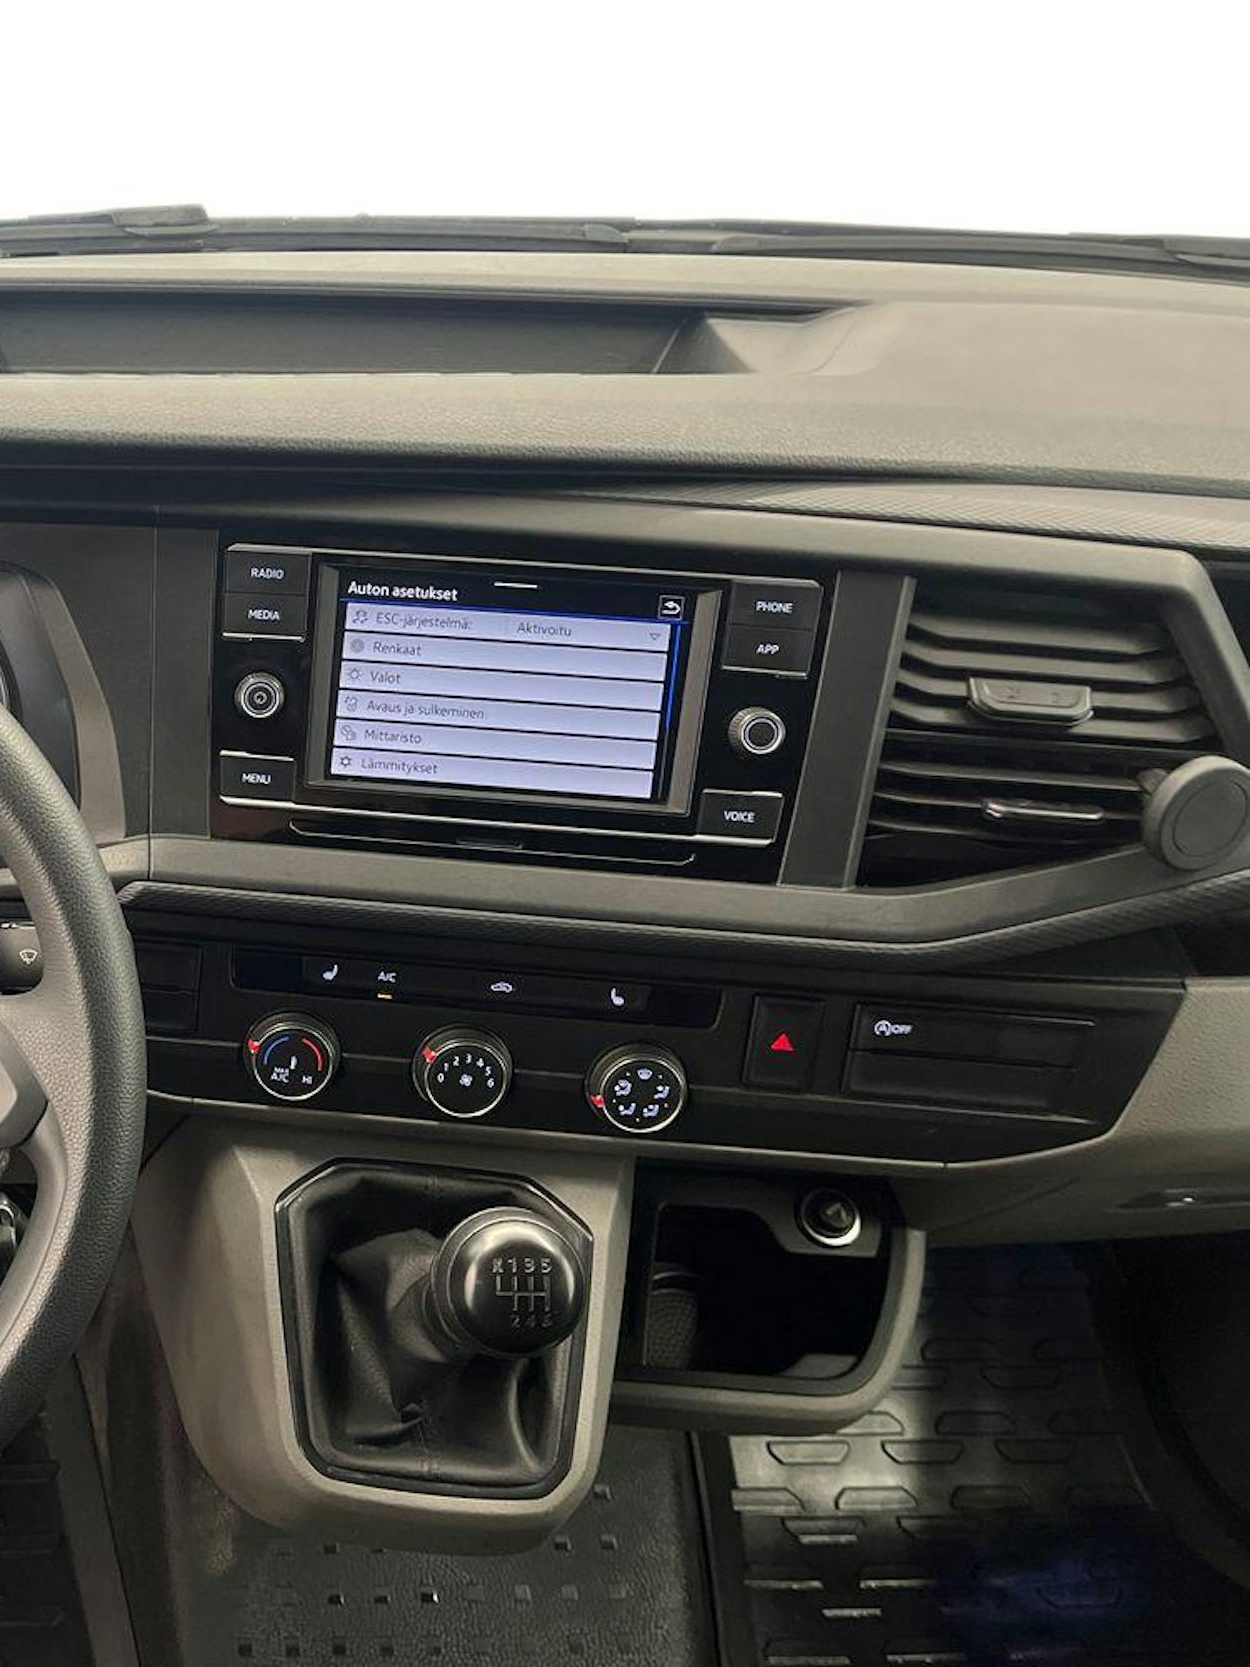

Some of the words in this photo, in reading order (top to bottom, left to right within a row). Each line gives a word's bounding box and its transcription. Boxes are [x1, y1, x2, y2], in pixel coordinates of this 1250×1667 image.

[251, 567, 285, 580] RADIO
[348, 581, 390, 597] Auton
[392, 586, 458, 601] asetukset
[755, 601, 794, 614] PHONE
[247, 609, 280, 621] MEDIA
[516, 622, 572, 637] Aktivoitu
[372, 641, 422, 657] Renkaat
[755, 643, 780, 655] APP
[370, 671, 402, 685] Valot
[366, 700, 401, 714] Avaus
[404, 704, 415, 717] ja
[417, 704, 485, 720] sulkeminen
[364, 729, 423, 745] Mittaristo
[361, 757, 439, 775] Lämmitykset
[241, 772, 271, 785] MENU
[724, 810, 756, 824] VOICE
[377, 970, 397, 983] A/C
[452, 1055, 460, 1067] 2
[465, 1053, 472, 1065] 3
[476, 1057, 485, 1068] 4
[437, 1072, 445, 1083] 0
[484, 1066, 492, 1076] 5
[487, 1077, 495, 1088] 6
[523, 1257, 535, 1273] 3
[540, 1257, 553, 1273] 5
